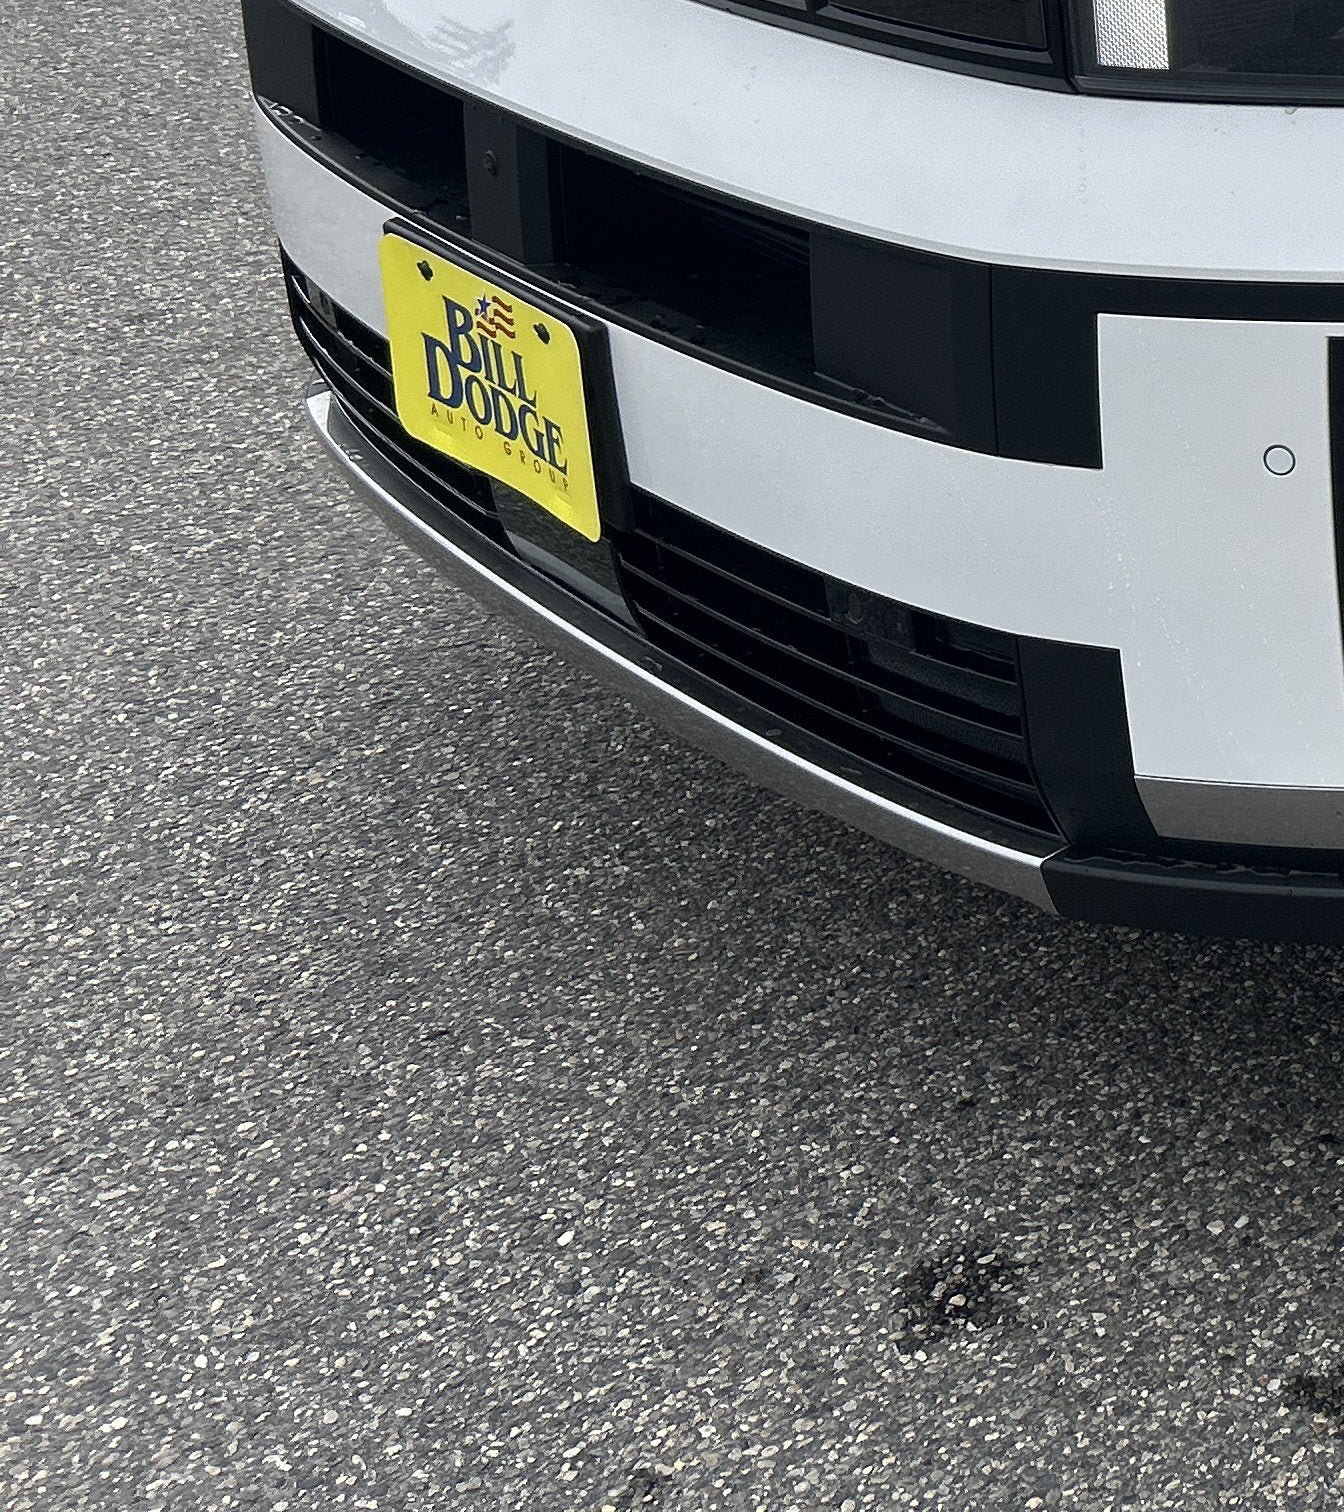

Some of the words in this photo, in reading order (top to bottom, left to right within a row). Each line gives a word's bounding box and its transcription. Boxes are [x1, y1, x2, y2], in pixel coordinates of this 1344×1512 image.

[420, 331, 568, 476] DODGE
[442, 294, 538, 409] BILL
[431, 402, 484, 440] AUTO
[503, 440, 570, 492] GROUP
